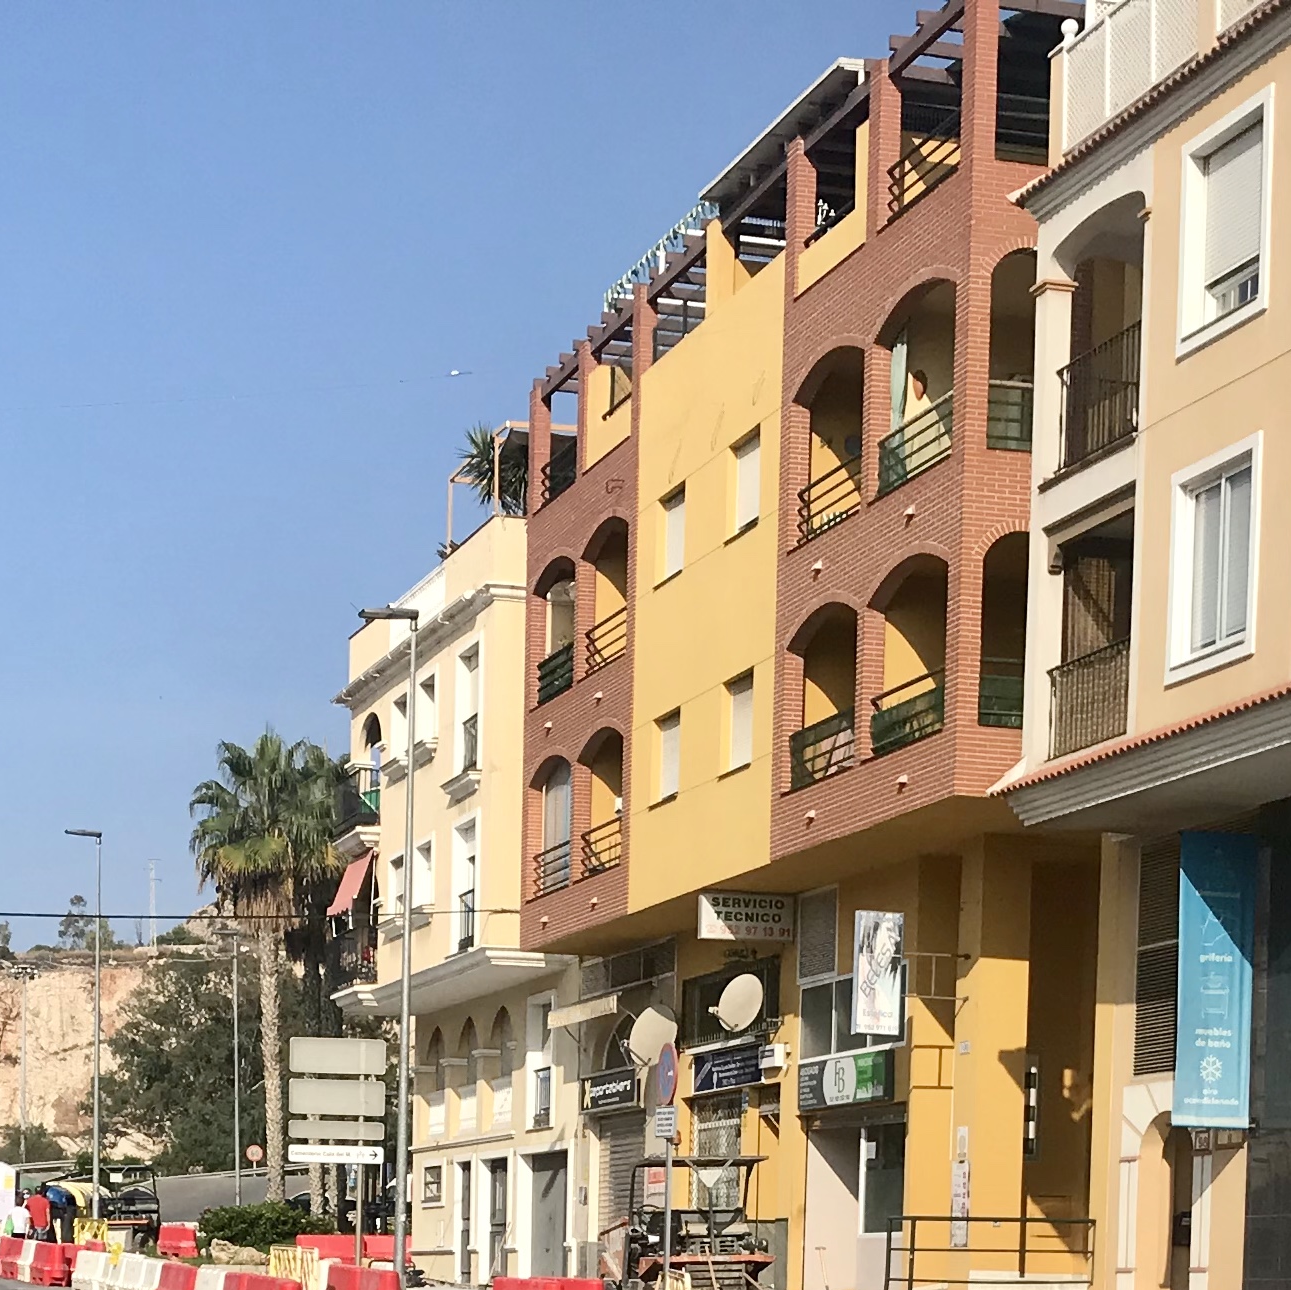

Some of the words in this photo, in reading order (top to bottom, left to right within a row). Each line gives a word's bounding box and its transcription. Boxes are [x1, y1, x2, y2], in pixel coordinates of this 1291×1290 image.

[711, 896, 785, 910] SERVICIO
[714, 910, 782, 923] TECNICO
[745, 926, 759, 936] 97
[763, 926, 774, 937] 13
[778, 927, 791, 938] 91
[1195, 1027, 1232, 1037] muebles
[1195, 1038, 1207, 1048] de
